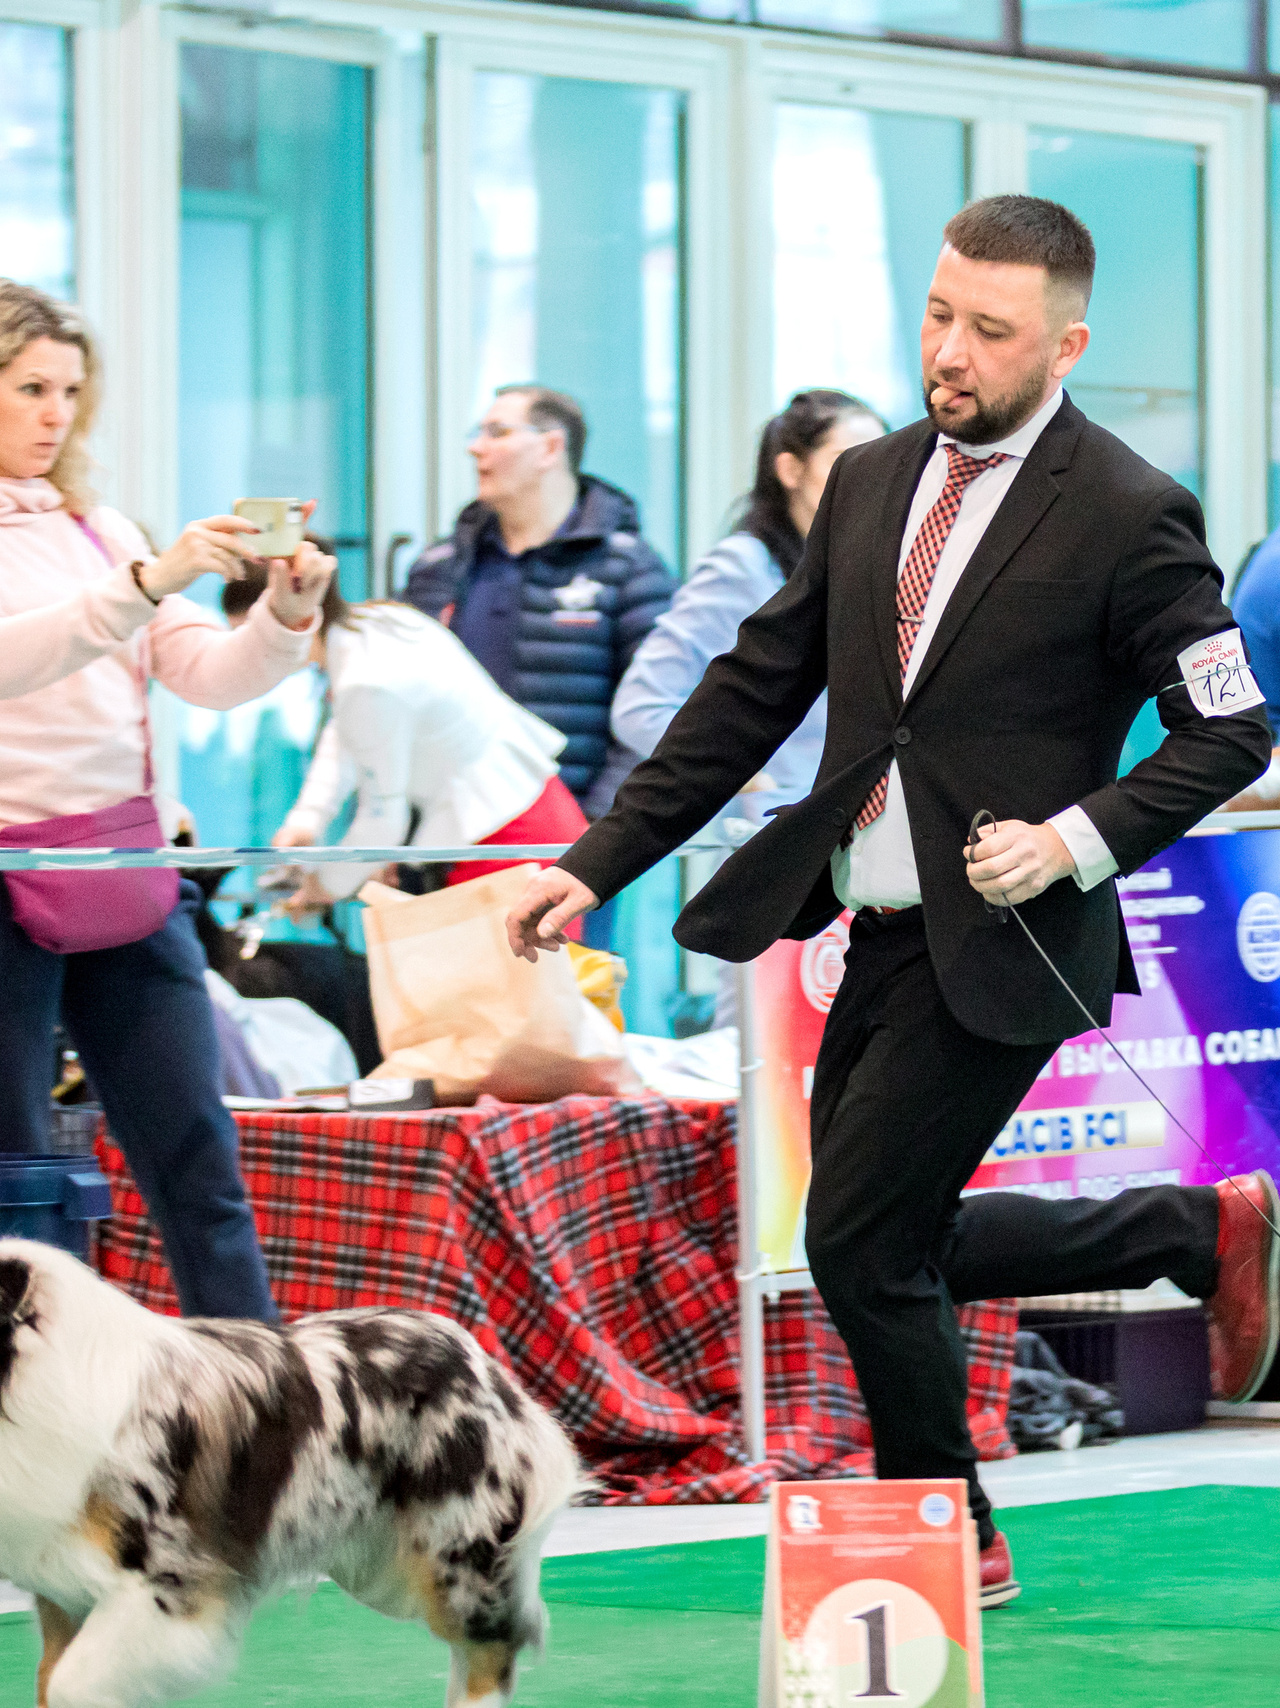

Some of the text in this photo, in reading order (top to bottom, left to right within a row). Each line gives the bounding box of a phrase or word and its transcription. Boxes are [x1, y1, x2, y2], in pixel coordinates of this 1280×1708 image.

[1191, 656, 1217, 670] ROYAL
[1202, 657, 1246, 707] 121
[1059, 1034, 1203, 1077] ВЫСТАВКА
[1083, 1110, 1127, 1149] FCI
[850, 1603, 902, 1698] 1
